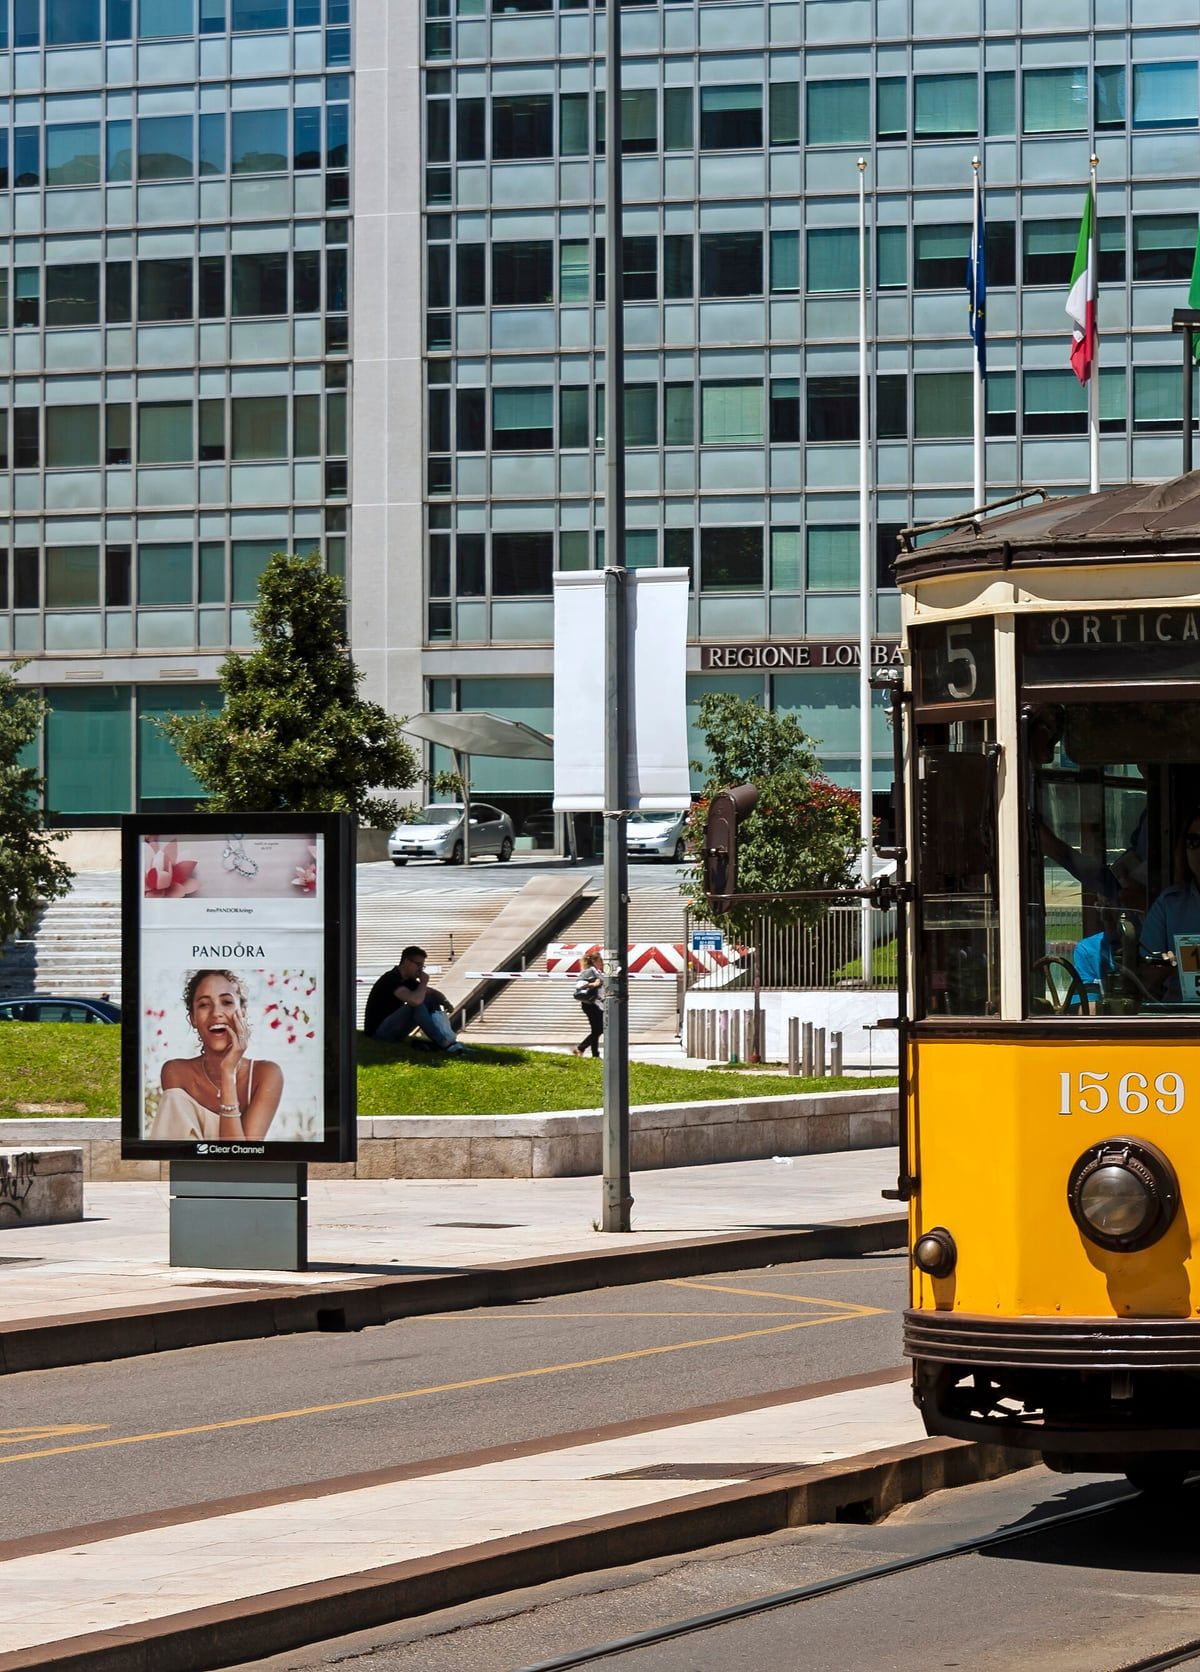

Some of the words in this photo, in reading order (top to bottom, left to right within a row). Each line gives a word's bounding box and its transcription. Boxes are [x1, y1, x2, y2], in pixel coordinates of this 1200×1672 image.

[1051, 612, 1199, 644] ORTICA
[709, 646, 810, 667] REGIONE
[947, 624, 977, 699] 5
[192, 942, 265, 958] PANDORA
[1191, 944, 1200, 973] 1
[1058, 1072, 1185, 1115] 1569
[209, 1145, 230, 1154] Clear
[231, 1145, 265, 1154] Channel
